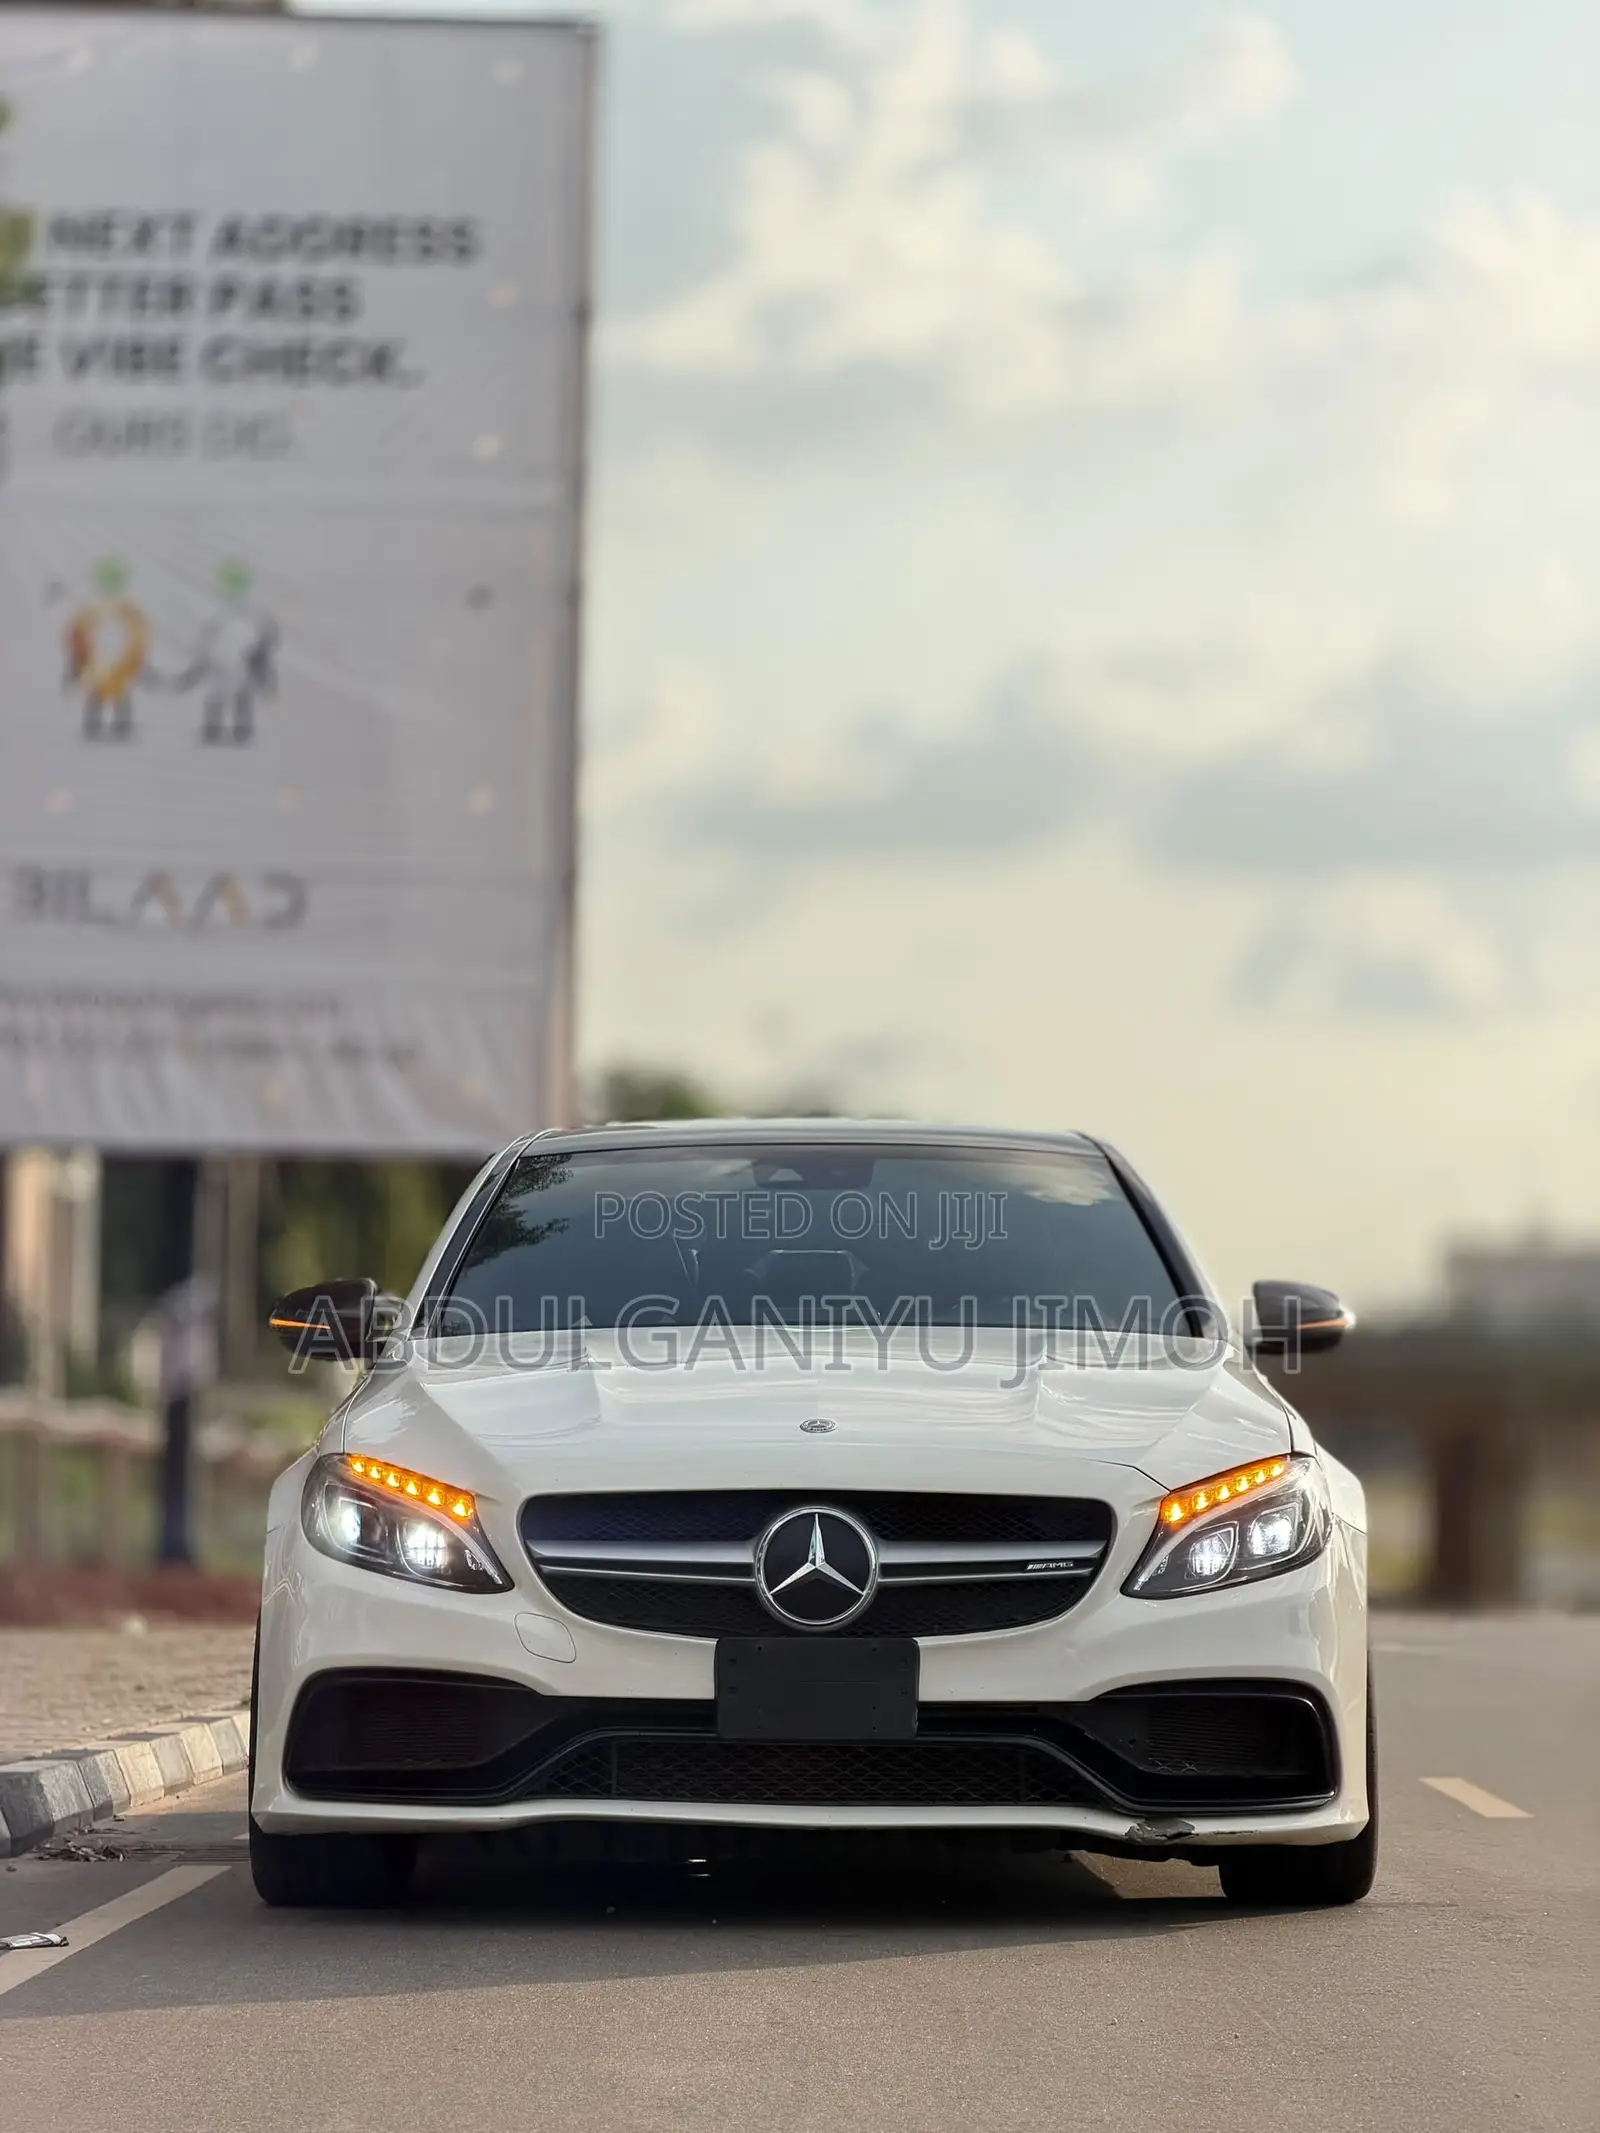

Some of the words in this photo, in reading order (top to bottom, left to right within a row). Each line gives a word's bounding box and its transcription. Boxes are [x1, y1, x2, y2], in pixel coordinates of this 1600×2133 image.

[49, 210, 194, 256] NEXT
[214, 215, 480, 265] ADDRESS
[2, 270, 194, 318] ETTER
[207, 274, 363, 324] PASS
